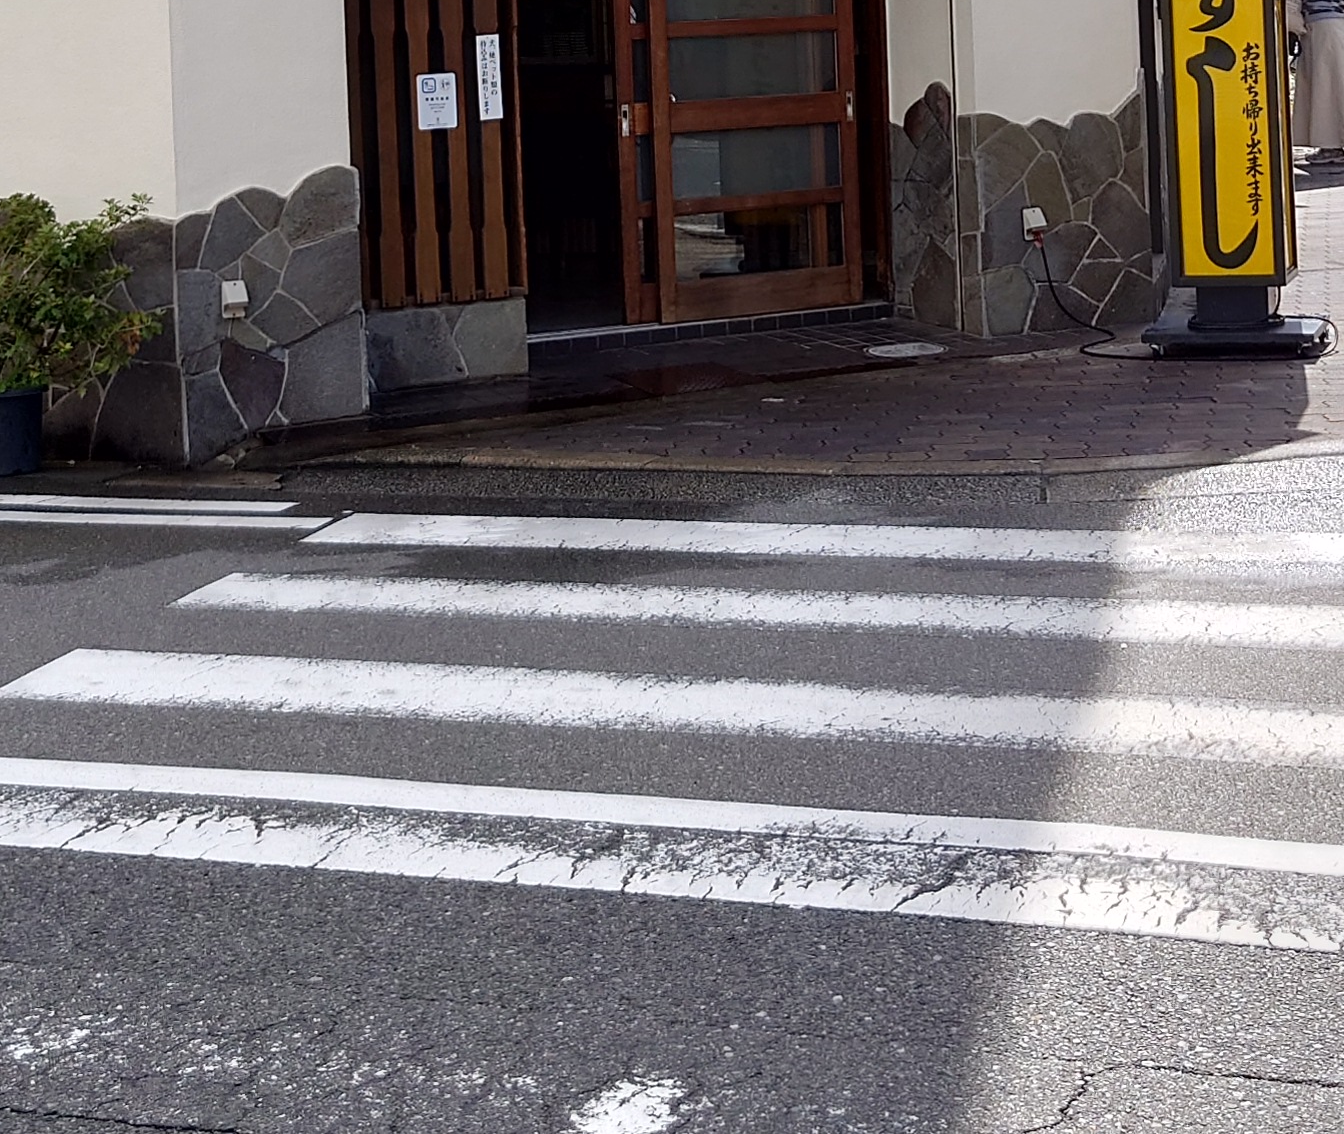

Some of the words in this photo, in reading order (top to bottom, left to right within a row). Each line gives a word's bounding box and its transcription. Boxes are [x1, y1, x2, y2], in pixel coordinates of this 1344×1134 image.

[1240, 43, 1263, 217] お持ち帰り出来ます
